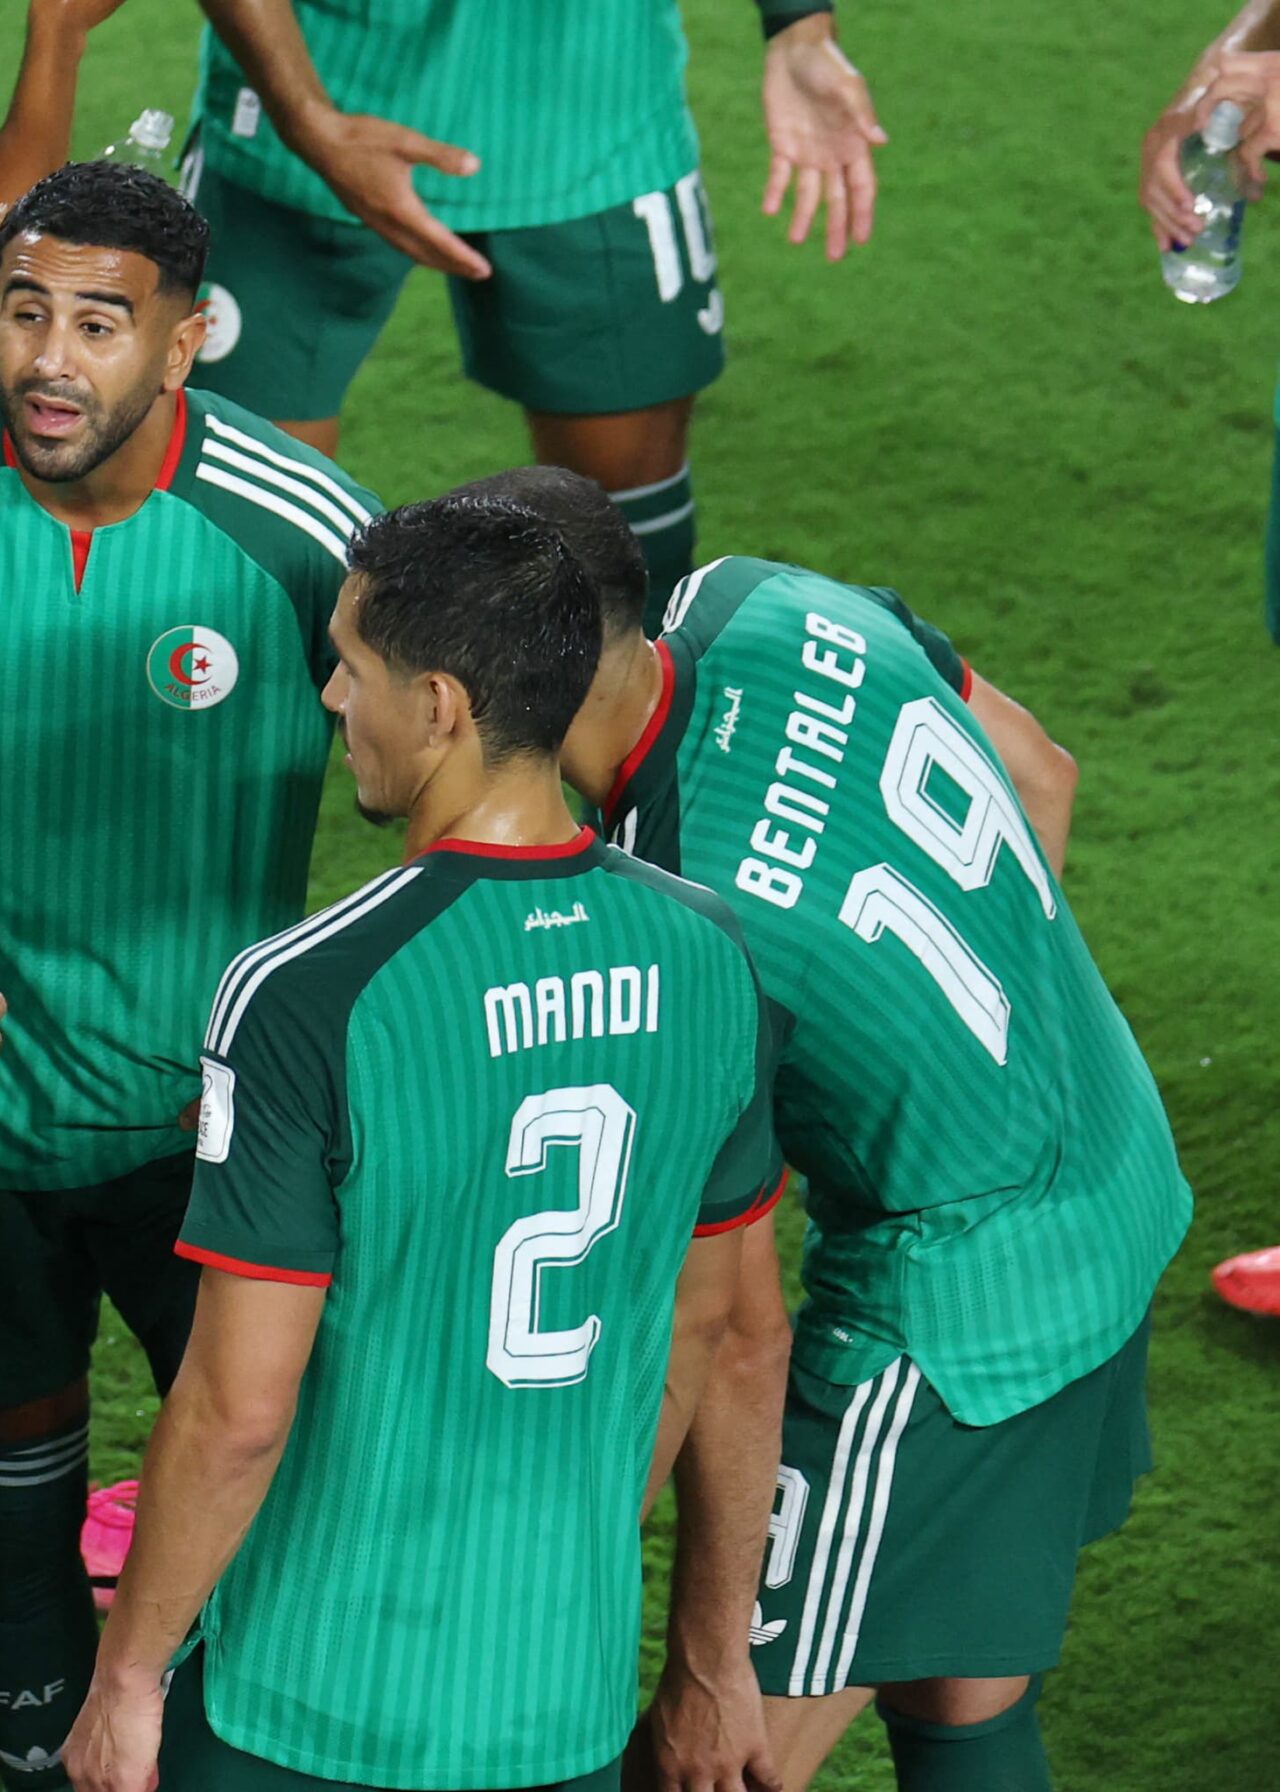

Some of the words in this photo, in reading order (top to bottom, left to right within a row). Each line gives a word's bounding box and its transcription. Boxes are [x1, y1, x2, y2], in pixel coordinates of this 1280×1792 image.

[164, 684, 221, 702] ALGERIA
[735, 612, 867, 910] BENTALEB
[483, 964, 660, 1058] MANDI
[838, 696, 1057, 1066] 19
[486, 1084, 637, 1389] 2
